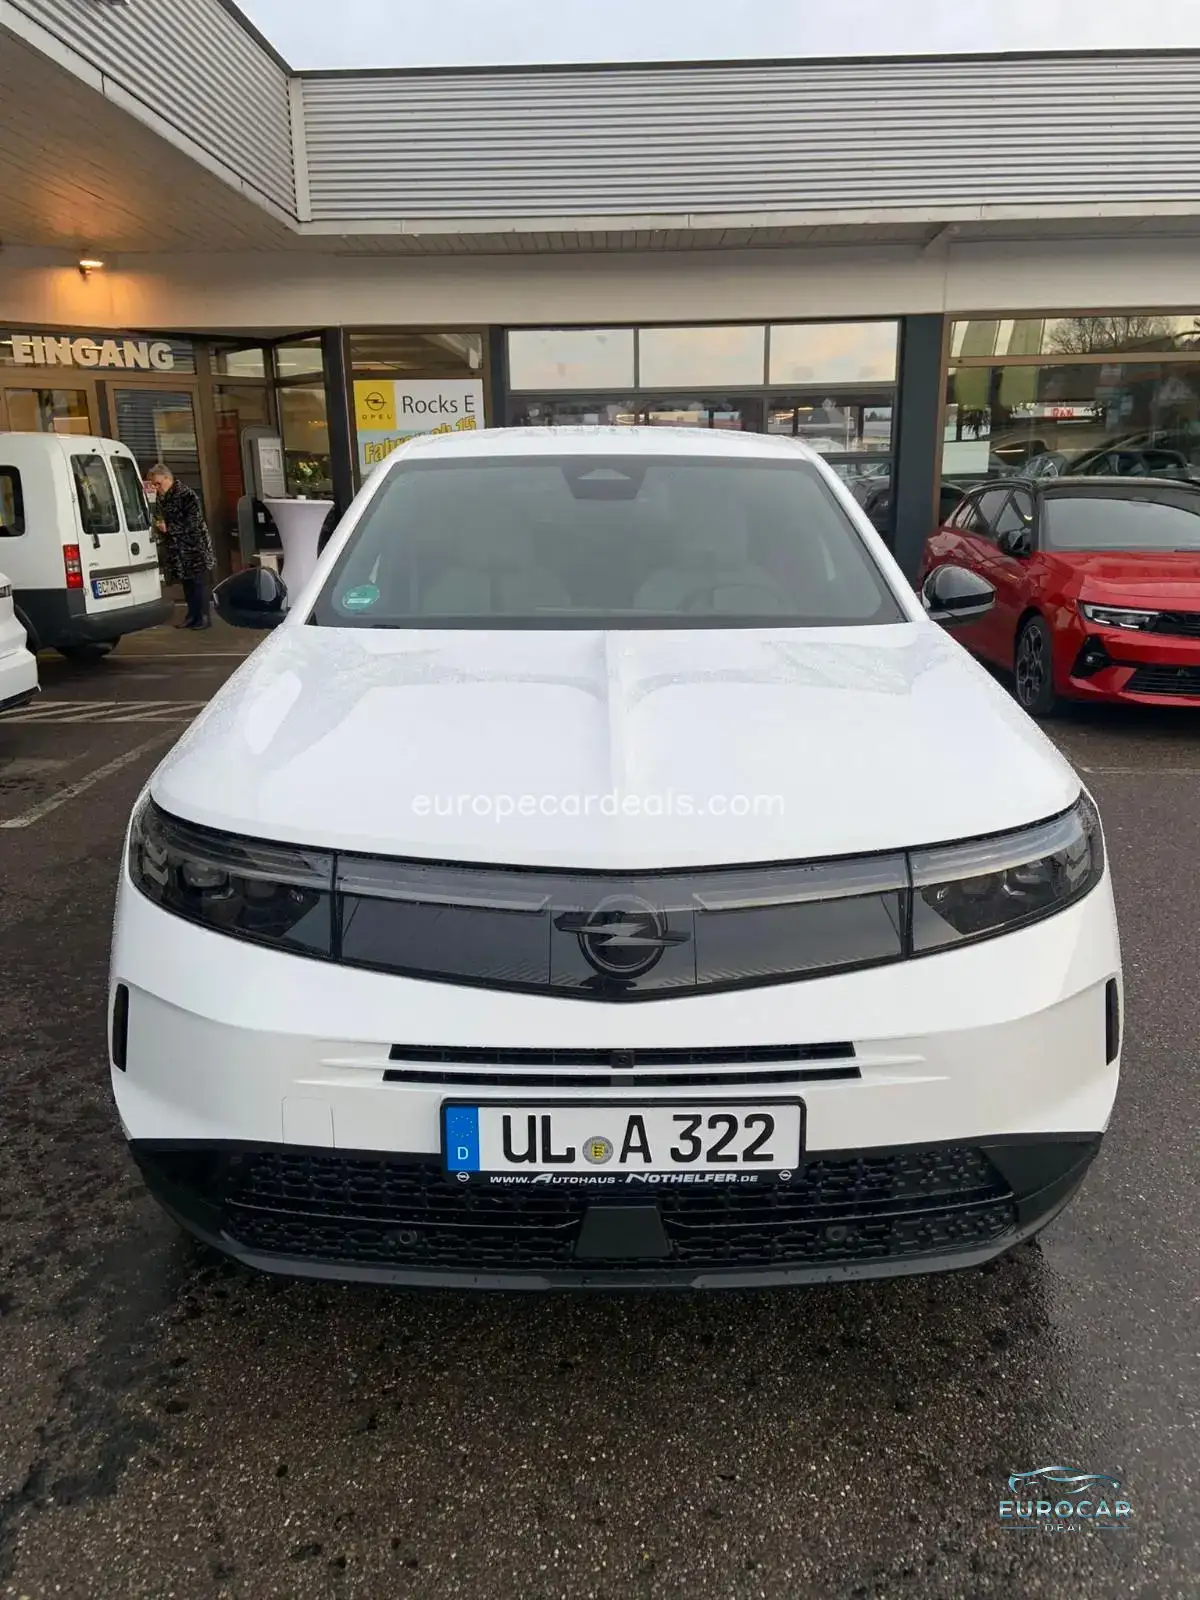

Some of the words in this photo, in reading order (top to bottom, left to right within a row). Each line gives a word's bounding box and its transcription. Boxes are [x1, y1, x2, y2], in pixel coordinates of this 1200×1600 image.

[11, 335, 174, 370] EINGANG
[402, 394, 458, 414] Rocks
[465, 395, 475, 413] E
[457, 1146, 469, 1160] D
[502, 1114, 576, 1163] UL
[619, 1115, 652, 1163] A
[671, 1113, 775, 1163] 322
